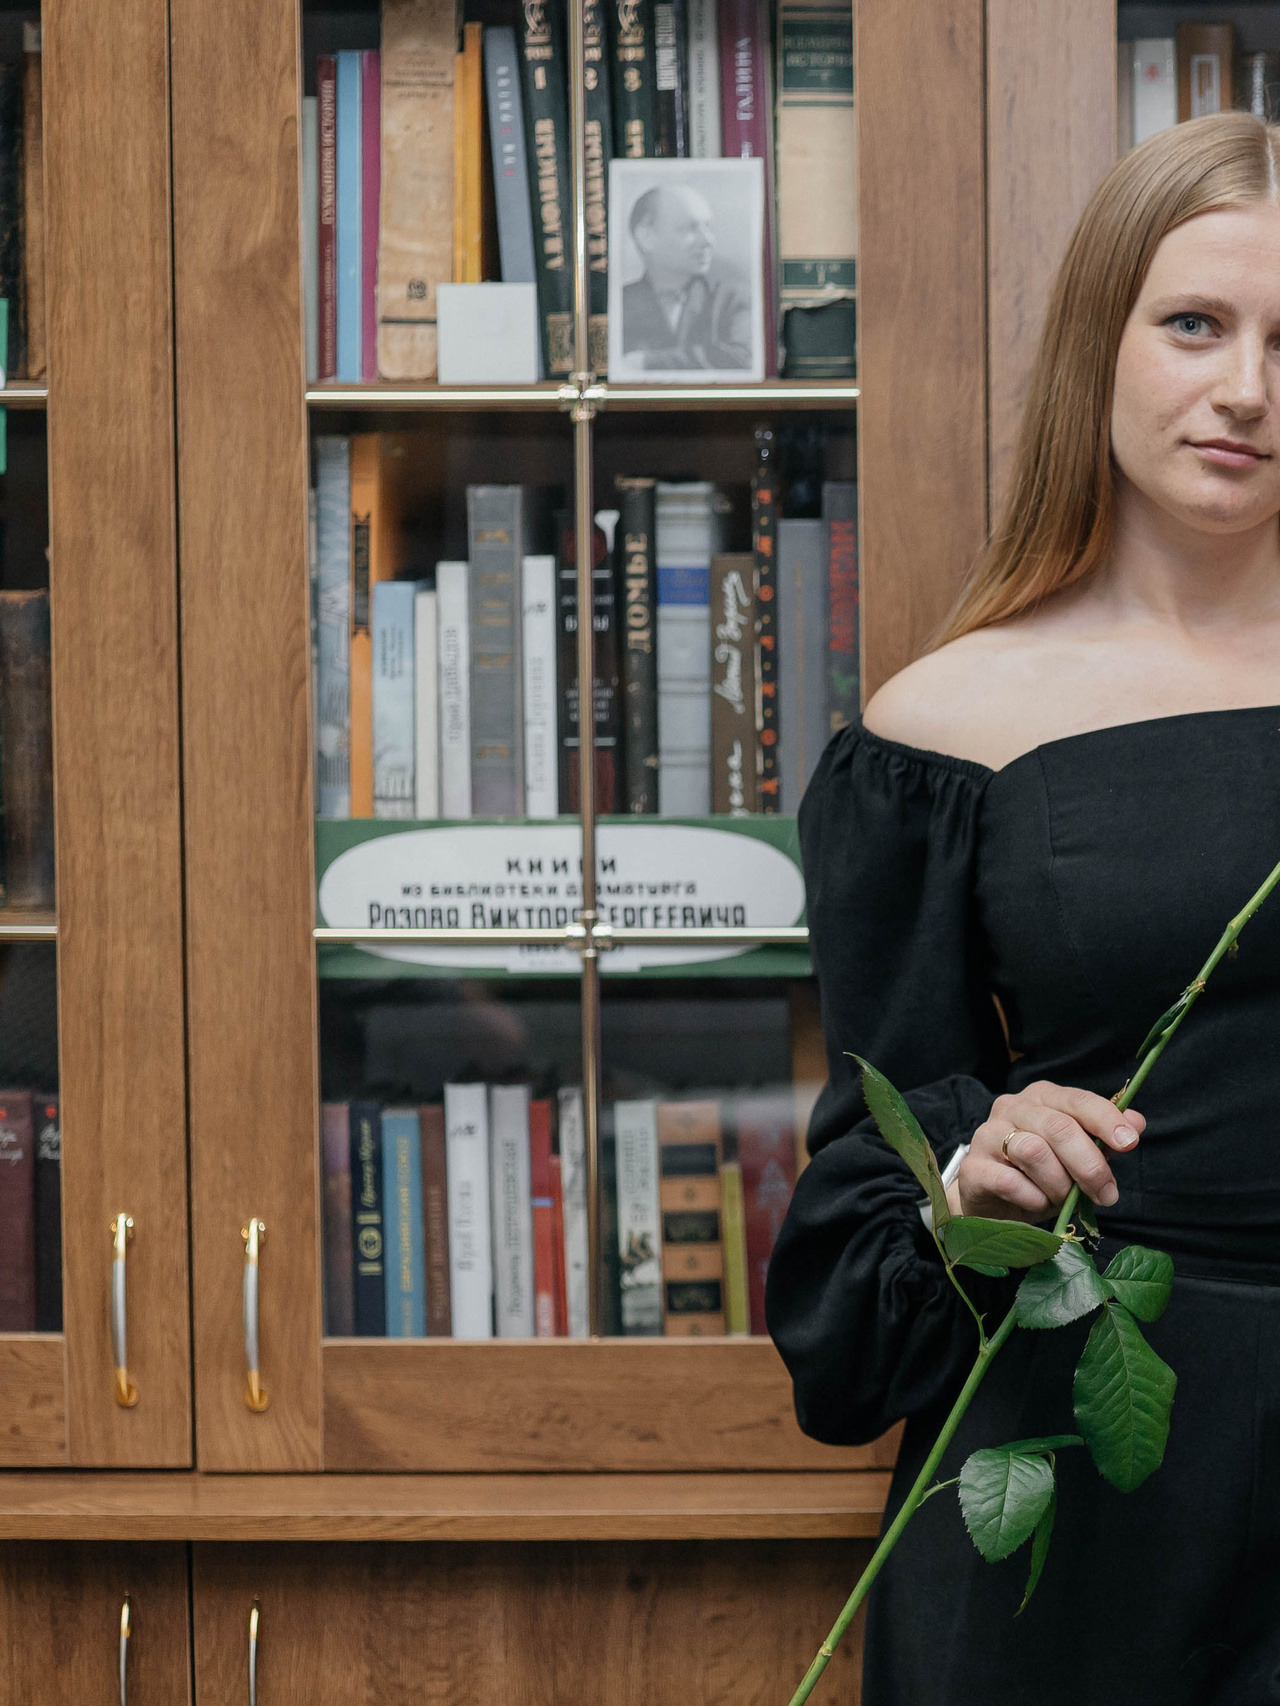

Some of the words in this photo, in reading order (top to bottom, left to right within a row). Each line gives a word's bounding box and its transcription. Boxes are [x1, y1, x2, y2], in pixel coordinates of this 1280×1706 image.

[734, 36, 755, 121] ГАЛИНА
[624, 532, 651, 654] ДОМЬЕ
[400, 882, 424, 898] ИЗ
[429, 882, 559, 898] БИБЛИОТЕКИ
[507, 858, 618, 876] КНИИ
